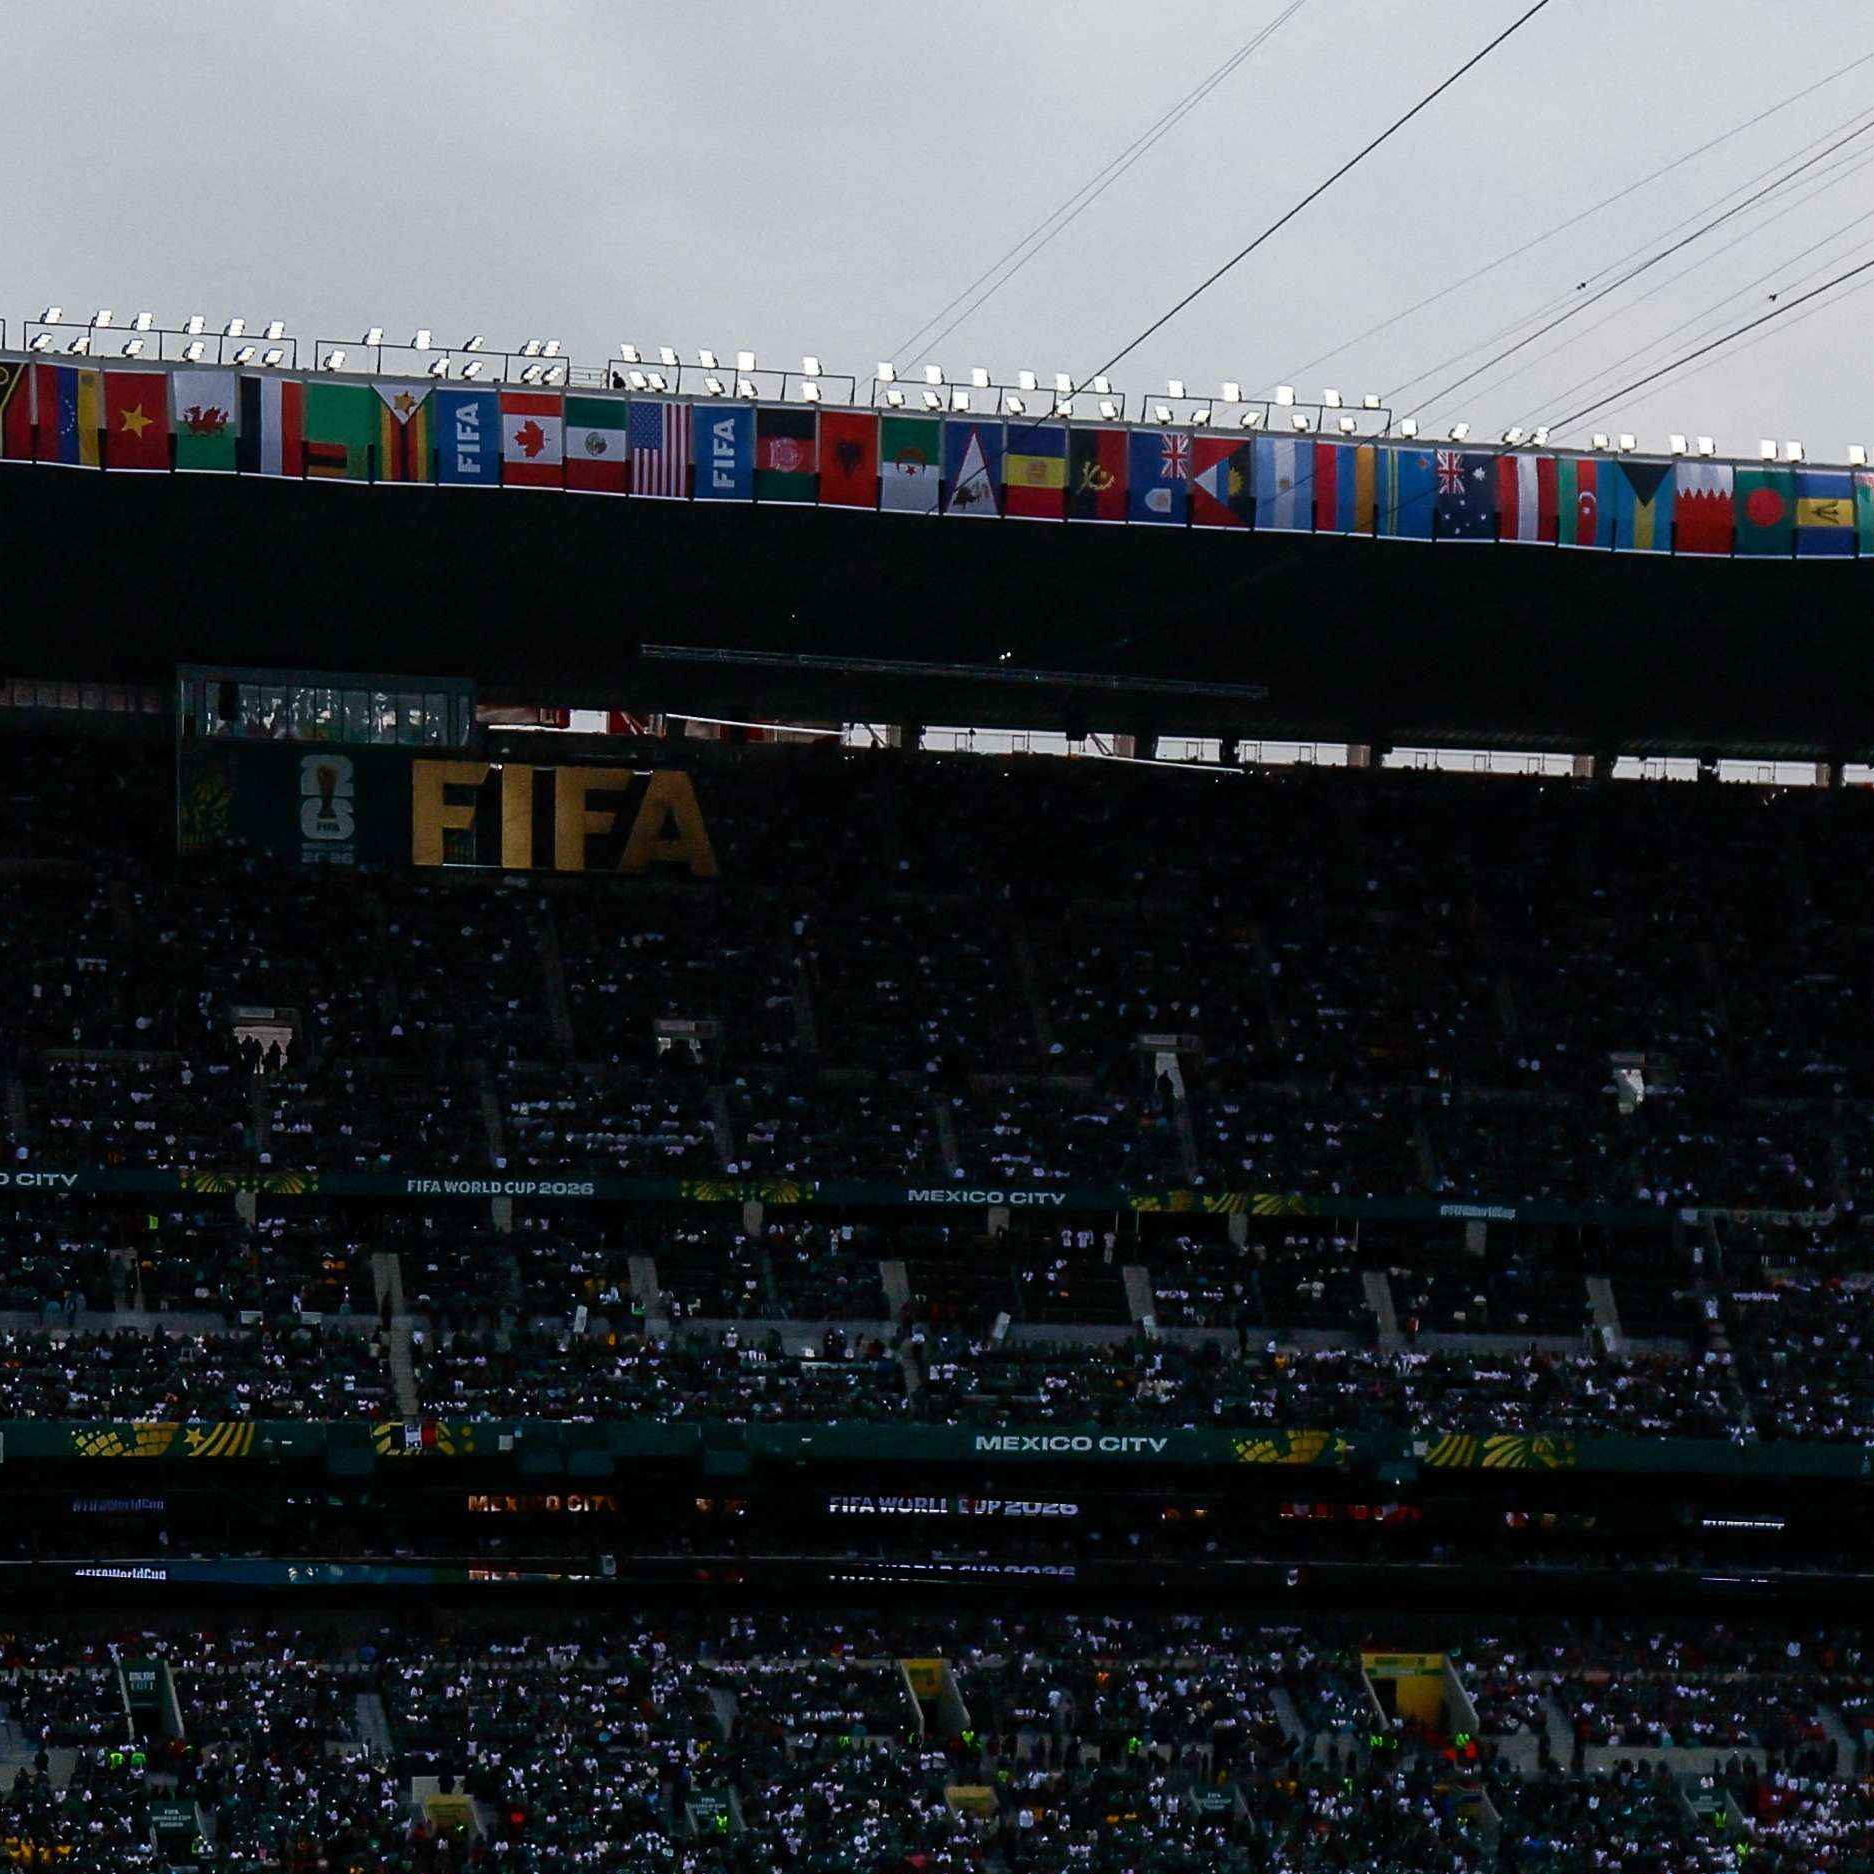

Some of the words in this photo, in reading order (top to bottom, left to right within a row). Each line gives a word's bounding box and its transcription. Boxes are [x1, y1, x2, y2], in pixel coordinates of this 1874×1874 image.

[456, 402, 481, 473] FIFA
[713, 415, 735, 488] FIFA
[412, 757, 720, 879] FIFA
[14, 1172, 79, 1187] CITY
[407, 1179, 442, 1193] FIFA
[443, 1180, 503, 1195] WORLD
[504, 1181, 537, 1196] CUP
[538, 1182, 595, 1196] 2026
[907, 1188, 1005, 1204] MEXICO
[1008, 1190, 1068, 1206] CITY
[974, 1434, 1093, 1451] MEXICO
[1097, 1434, 1169, 1452] CITY
[1004, 1501, 1080, 1516] 2026
